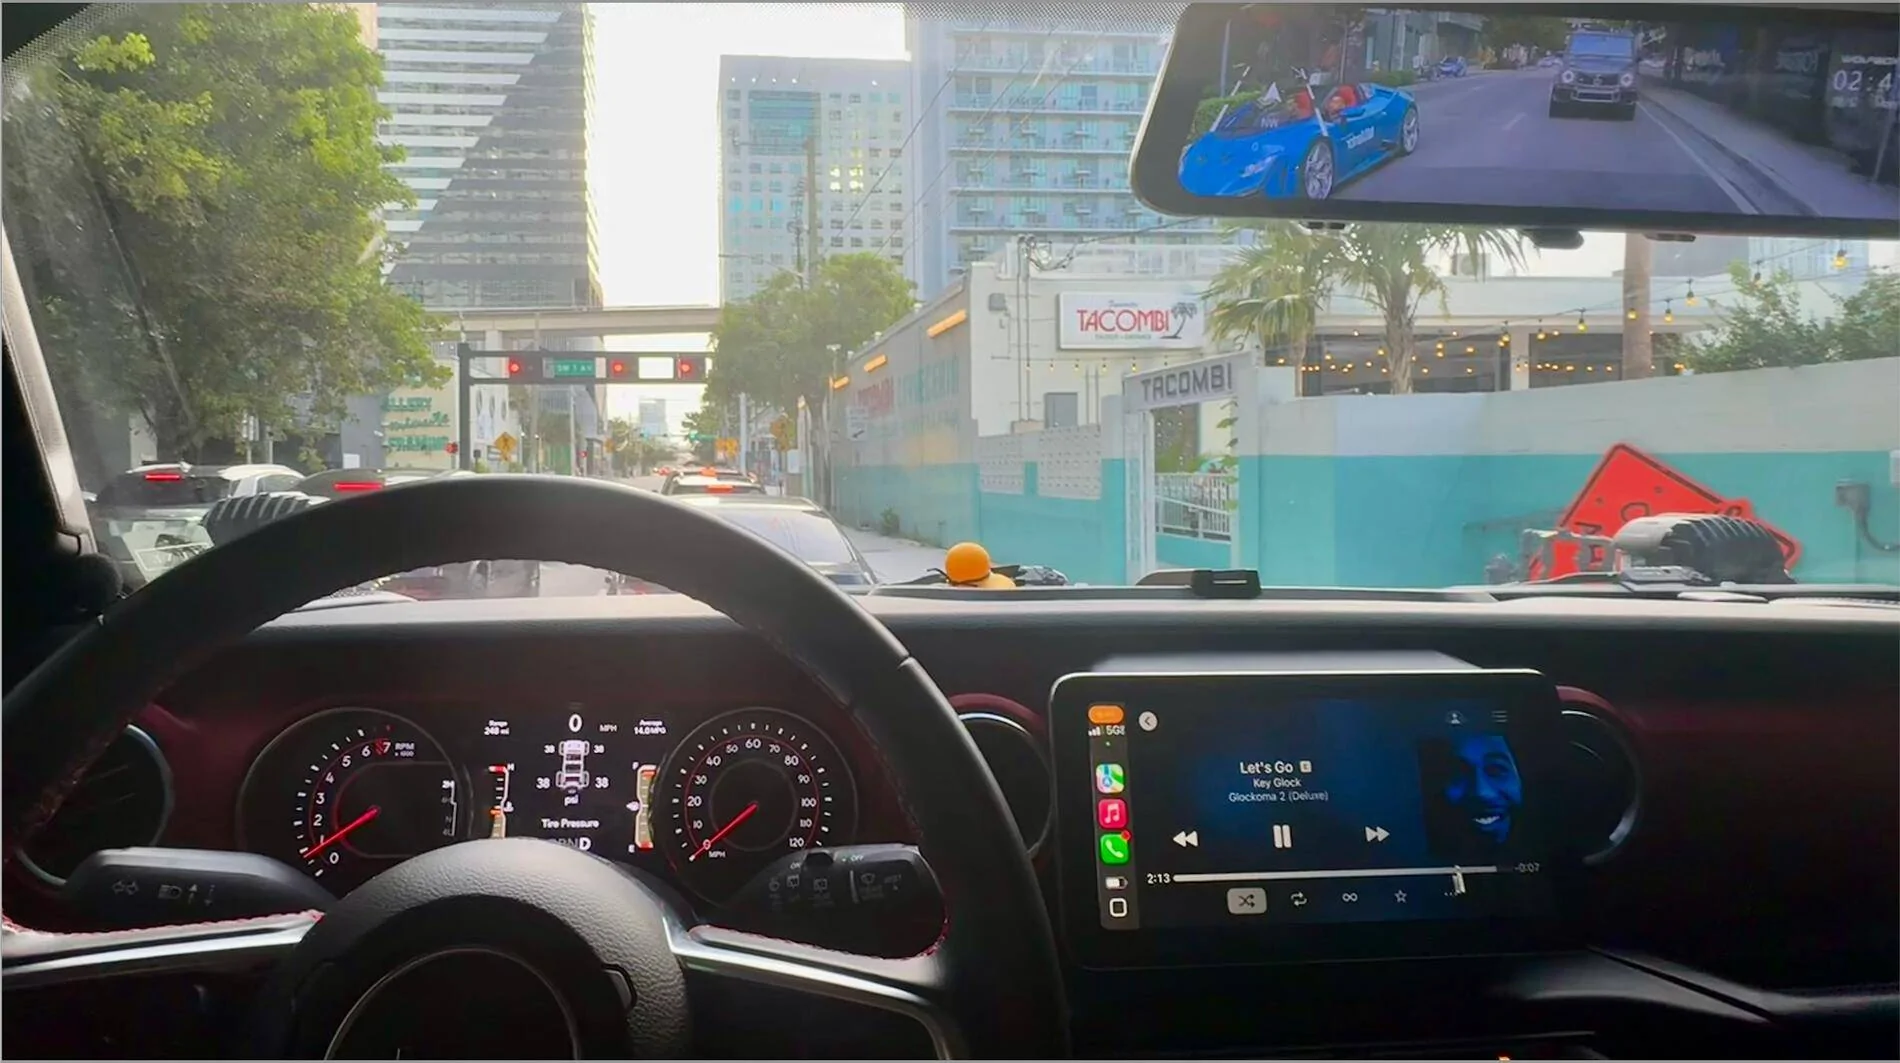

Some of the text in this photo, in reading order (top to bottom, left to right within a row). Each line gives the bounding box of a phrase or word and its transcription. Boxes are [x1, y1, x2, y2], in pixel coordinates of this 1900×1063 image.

[1077, 309, 1169, 332] TACOMBI
[1141, 362, 1232, 401] TACOMBI
[569, 714, 582, 732] 0
[382, 741, 391, 754] 7
[395, 743, 414, 751] RPM
[726, 744, 738, 753] 50
[745, 738, 761, 749] 60
[768, 744, 780, 753] 70
[361, 745, 371, 757] 6
[342, 755, 351, 767] 5
[706, 755, 721, 766] 40
[784, 755, 799, 766] 80
[1240, 762, 1272, 774] Let's
[1274, 761, 1293, 773] Go
[325, 772, 334, 783] 4
[536, 777, 550, 789] 38
[595, 777, 609, 788] 38
[695, 775, 707, 785] 30
[798, 775, 810, 784] 90
[1253, 777, 1301, 789] Key Glock
[316, 793, 325, 804] 3
[564, 795, 579, 806] psi
[687, 796, 702, 807] 20
[1228, 790, 1329, 802] Glockoma 2 (Deluxe)
[801, 798, 816, 807] 100
[313, 814, 322, 826] 2
[542, 818, 599, 828] Tire Pressure
[693, 820, 703, 829] 10
[800, 819, 812, 828] 110
[789, 838, 804, 848] 120
[329, 852, 339, 864] 0
[1147, 873, 1170, 884] 2:13
